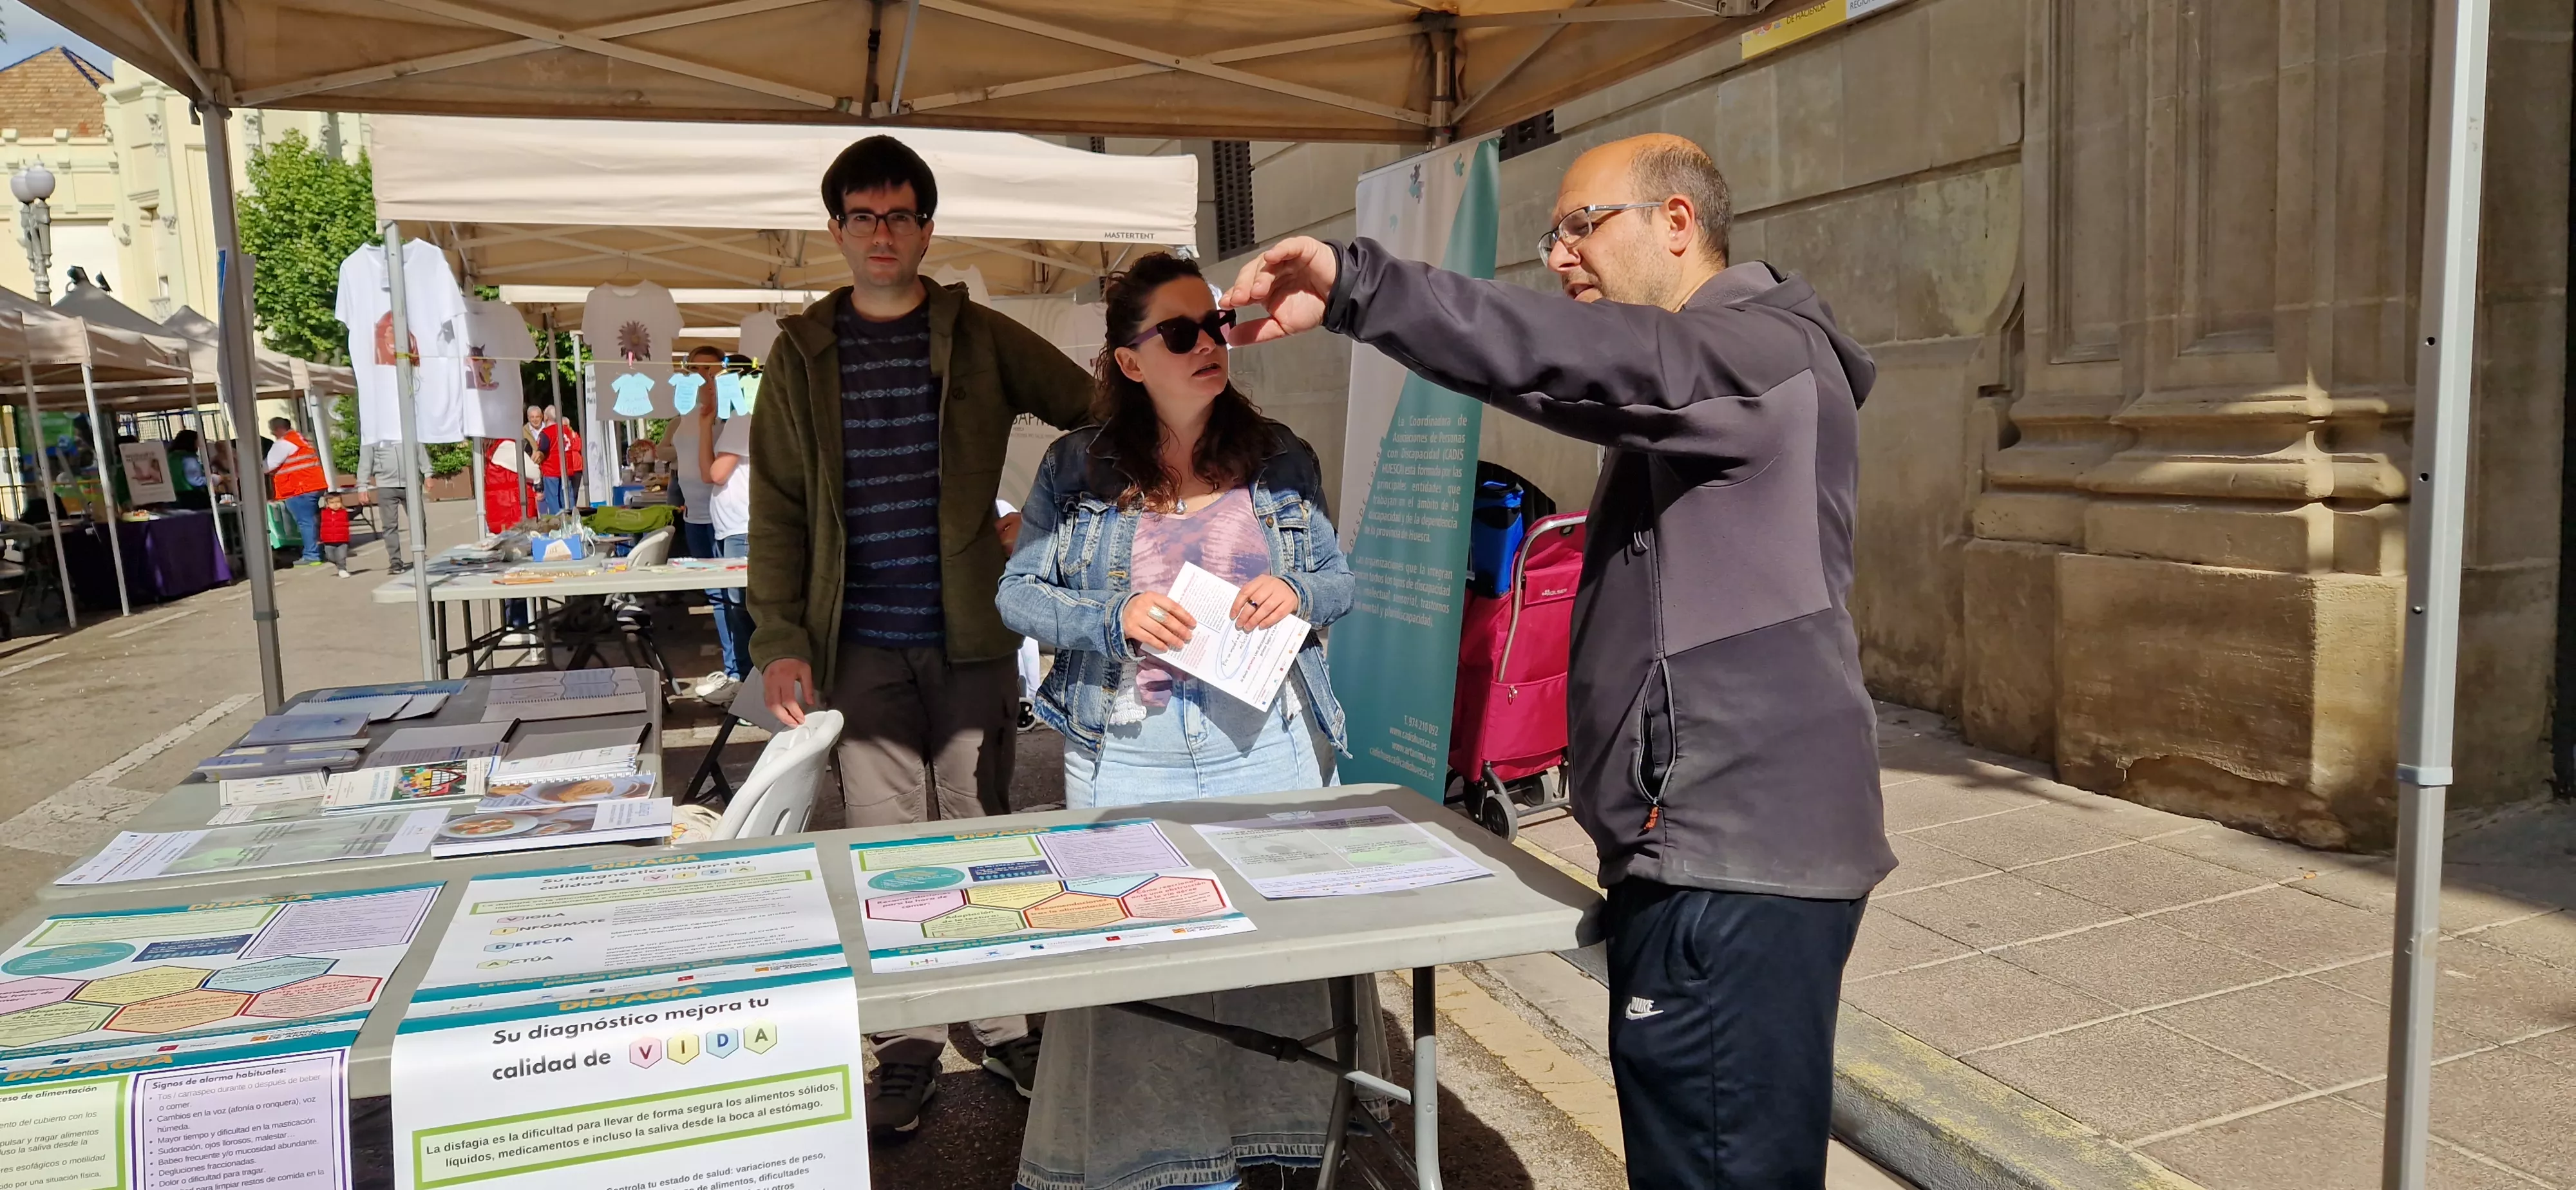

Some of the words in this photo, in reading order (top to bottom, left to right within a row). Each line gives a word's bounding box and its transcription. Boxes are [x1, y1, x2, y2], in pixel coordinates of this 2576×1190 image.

[1408, 716, 1418, 727] 974
[1418, 720, 1428, 732] 210
[1428, 722, 1439, 736] 092
[568, 869, 667, 881] diagnóstico
[672, 862, 730, 871] mejora
[591, 854, 700, 870] DISFAGIA
[540, 880, 603, 890] calidad
[187, 892, 314, 911] DISFAGIA
[502, 918, 605, 933] INFÓRMATE
[507, 912, 565, 921] VIGILA
[495, 937, 574, 949] DETECTA
[488, 956, 554, 967] ACTÚA
[559, 986, 701, 1012] DISFAGIA
[1631, 996, 1654, 1013] NIKE
[492, 1030, 521, 1044] Su
[527, 1014, 658, 1039] diagnóstico
[665, 1002, 741, 1021] mejora
[748, 997, 769, 1008] tu
[3, 1055, 173, 1082] DISFAGIA
[492, 1054, 576, 1080] calidad
[583, 1050, 611, 1067] de
[152, 1081, 183, 1090] Signos
[199, 1075, 233, 1083] alarma
[235, 1067, 286, 1079] habituales:
[35, 1086, 97, 1098] alimentación
[177, 1088, 216, 1098] carraspeo
[217, 1084, 246, 1093] durante
[254, 1079, 287, 1088] después
[156, 1113, 191, 1122] Cambios
[227, 1104, 254, 1114] (afonía
[262, 1098, 301, 1108] ronquera),
[166, 1102, 191, 1110] comer.
[19, 1118, 32, 1126] del
[33, 1115, 66, 1124] cubierto
[156, 1124, 190, 1133] húmeda.
[183, 1132, 209, 1140] tiempo
[216, 1126, 250, 1136] dificultad
[271, 1118, 317, 1128] masticación.
[426, 1146, 440, 1155] La
[444, 1138, 489, 1151] disfagia
[492, 1135, 506, 1144] es
[509, 1133, 518, 1142] la
[522, 1124, 573, 1139] dificultad
[576, 1120, 601, 1133] para
[603, 1115, 633, 1126] llevar
[636, 1112, 649, 1121] de
[652, 1108, 684, 1119] forma
[687, 1102, 723, 1113] segura
[726, 1099, 742, 1107] los
[744, 1090, 795, 1104] alimentos
[798, 1084, 838, 1095] sólidos,
[34, 1134, 58, 1142] tragar
[60, 1129, 99, 1139] alimentos
[445, 1153, 495, 1167] líquidos,
[498, 1139, 580, 1158] medicamentos
[592, 1131, 633, 1143] incluso
[634, 1128, 645, 1137] la
[647, 1123, 679, 1135] saliva
[681, 1117, 715, 1129] desde
[717, 1115, 726, 1123] la
[728, 1111, 755, 1121] boca
[757, 1107, 767, 1117] al
[769, 1100, 824, 1114] estómago.
[28, 1144, 52, 1152] saliva
[53, 1140, 79, 1149] desde
[157, 1144, 203, 1155] Sudoración,
[204, 1141, 221, 1149] ojos
[222, 1137, 253, 1146] llorosos,
[158, 1157, 184, 1166] Babeo
[184, 1152, 220, 1162] frecuente
[221, 1149, 234, 1159] y/o
[234, 1144, 276, 1155] mucosidad
[277, 1139, 319, 1149] abundante.
[15, 1160, 59, 1171] esofágicos
[69, 1154, 106, 1164] motilidad
[158, 1165, 205, 1176] Degluciones
[207, 1158, 256, 1169] fraccionadas.
[659, 1175, 690, 1186] estado
[706, 1167, 733, 1178] salud:
[735, 1159, 786, 1173] variaciones
[802, 1153, 826, 1163] peso,
[15, 1180, 27, 1189] por
[46, 1174, 78, 1183] situación
[158, 1179, 180, 1187] Dolor
[187, 1173, 222, 1183] dificultad
[222, 1171, 240, 1180] para
[242, 1167, 267, 1176] tragar.
[214, 1182, 240, 1190] limpiar
[241, 1178, 265, 1186] restos
[277, 1171, 305, 1181] comida
[711, 1176, 757, 1190] alimentos,
[759, 1167, 810, 1182] dificultades
